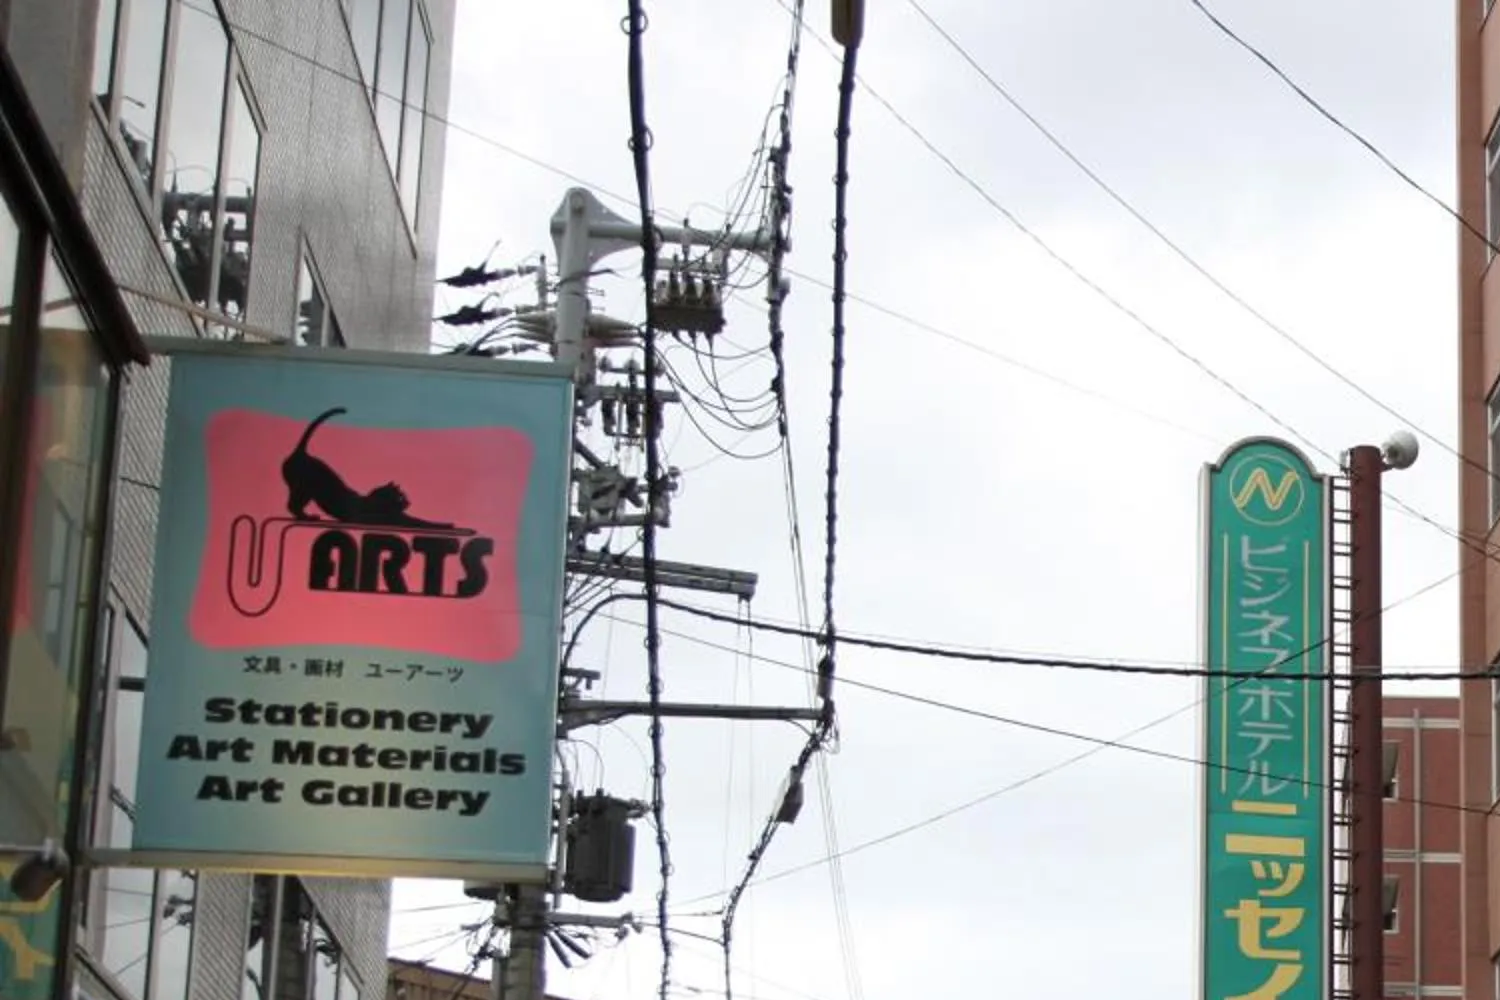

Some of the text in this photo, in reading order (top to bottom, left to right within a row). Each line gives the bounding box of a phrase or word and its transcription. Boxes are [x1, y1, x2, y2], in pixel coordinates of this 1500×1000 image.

[308, 530, 494, 599] ARTS
[365, 662, 466, 684] ユーアーツ
[1237, 533, 1295, 797] ビジネスホテル
[204, 697, 494, 740] Stationery
[166, 734, 527, 776] Art Materials
[195, 774, 491, 817] Art Gallery
